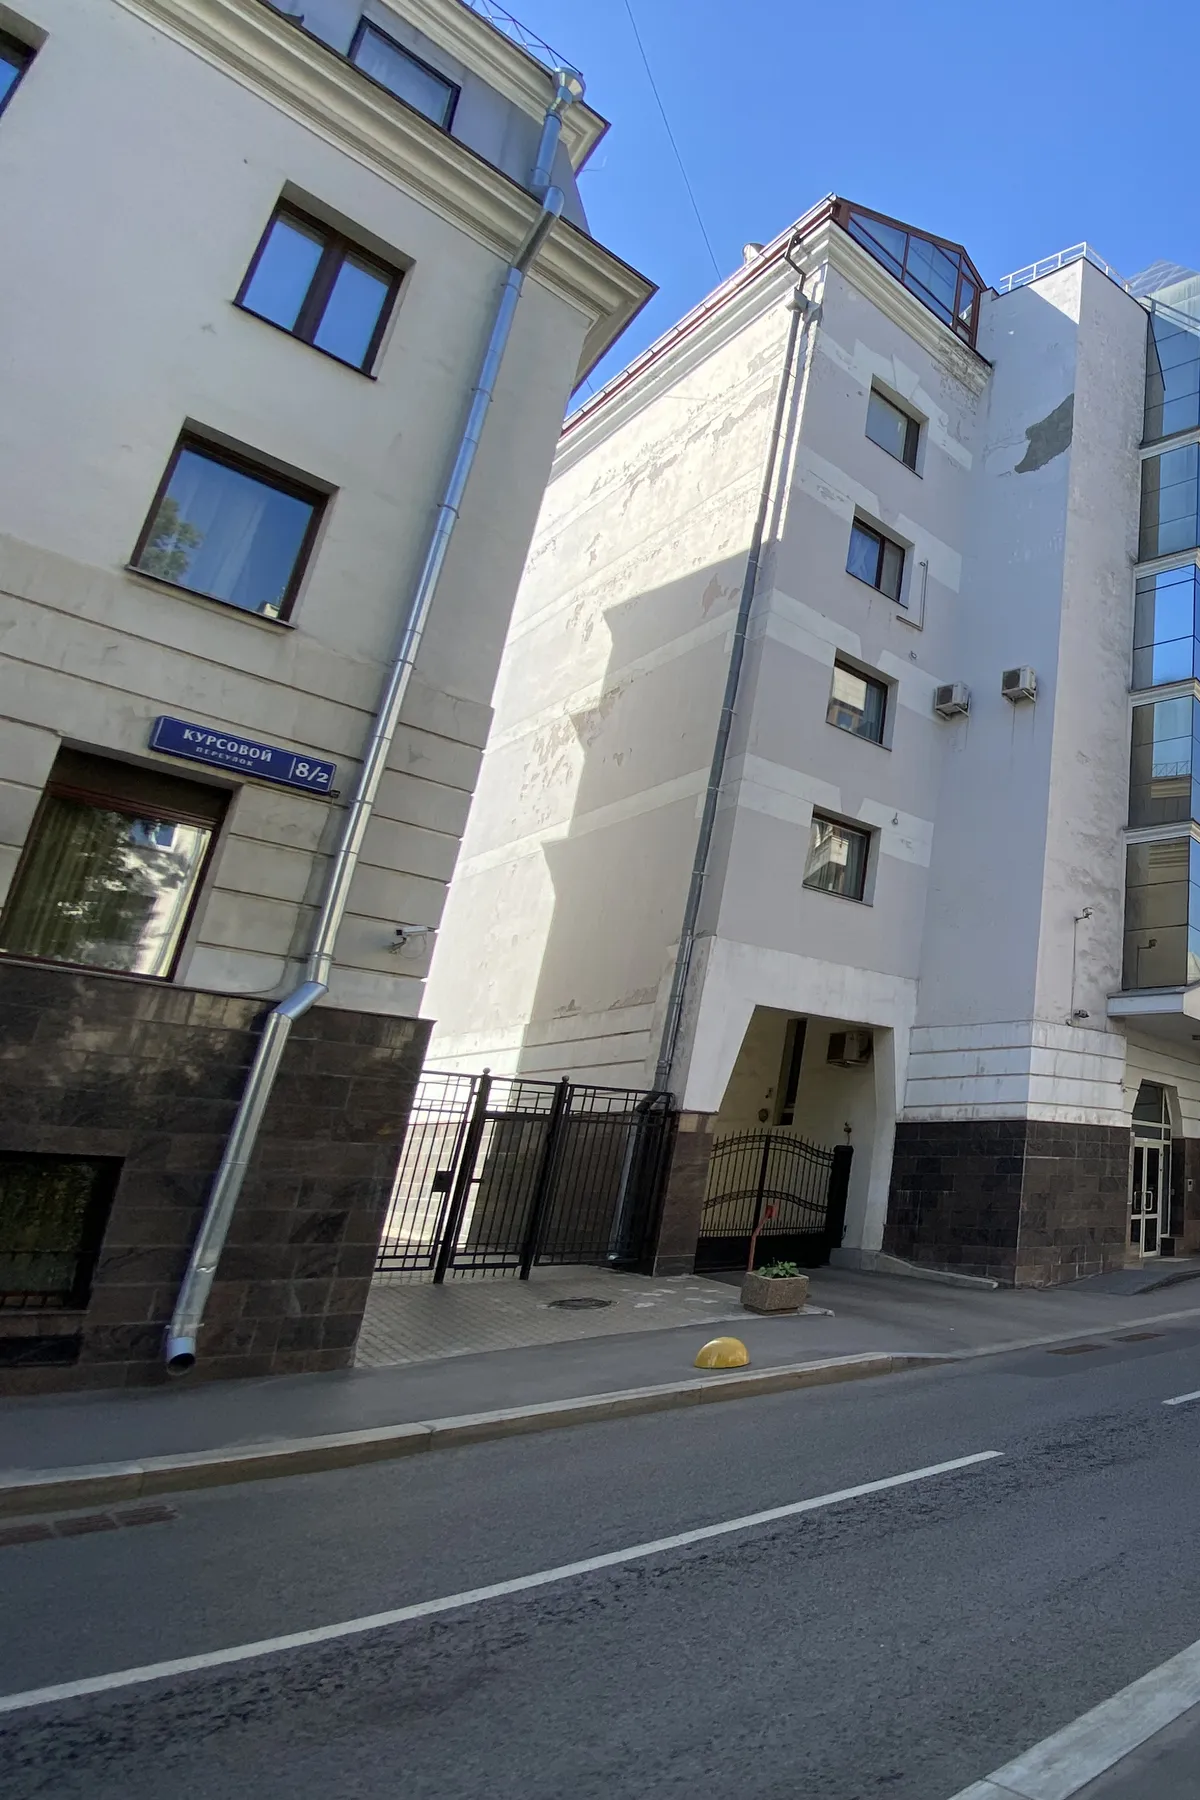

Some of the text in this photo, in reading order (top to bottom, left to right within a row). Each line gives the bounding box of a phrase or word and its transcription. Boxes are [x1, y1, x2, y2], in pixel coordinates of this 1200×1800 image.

[183, 728, 273, 763] КУРСОВОЙ
[195, 746, 254, 767] ПЕРЕУЛОК
[295, 761, 329, 784] 8/2
